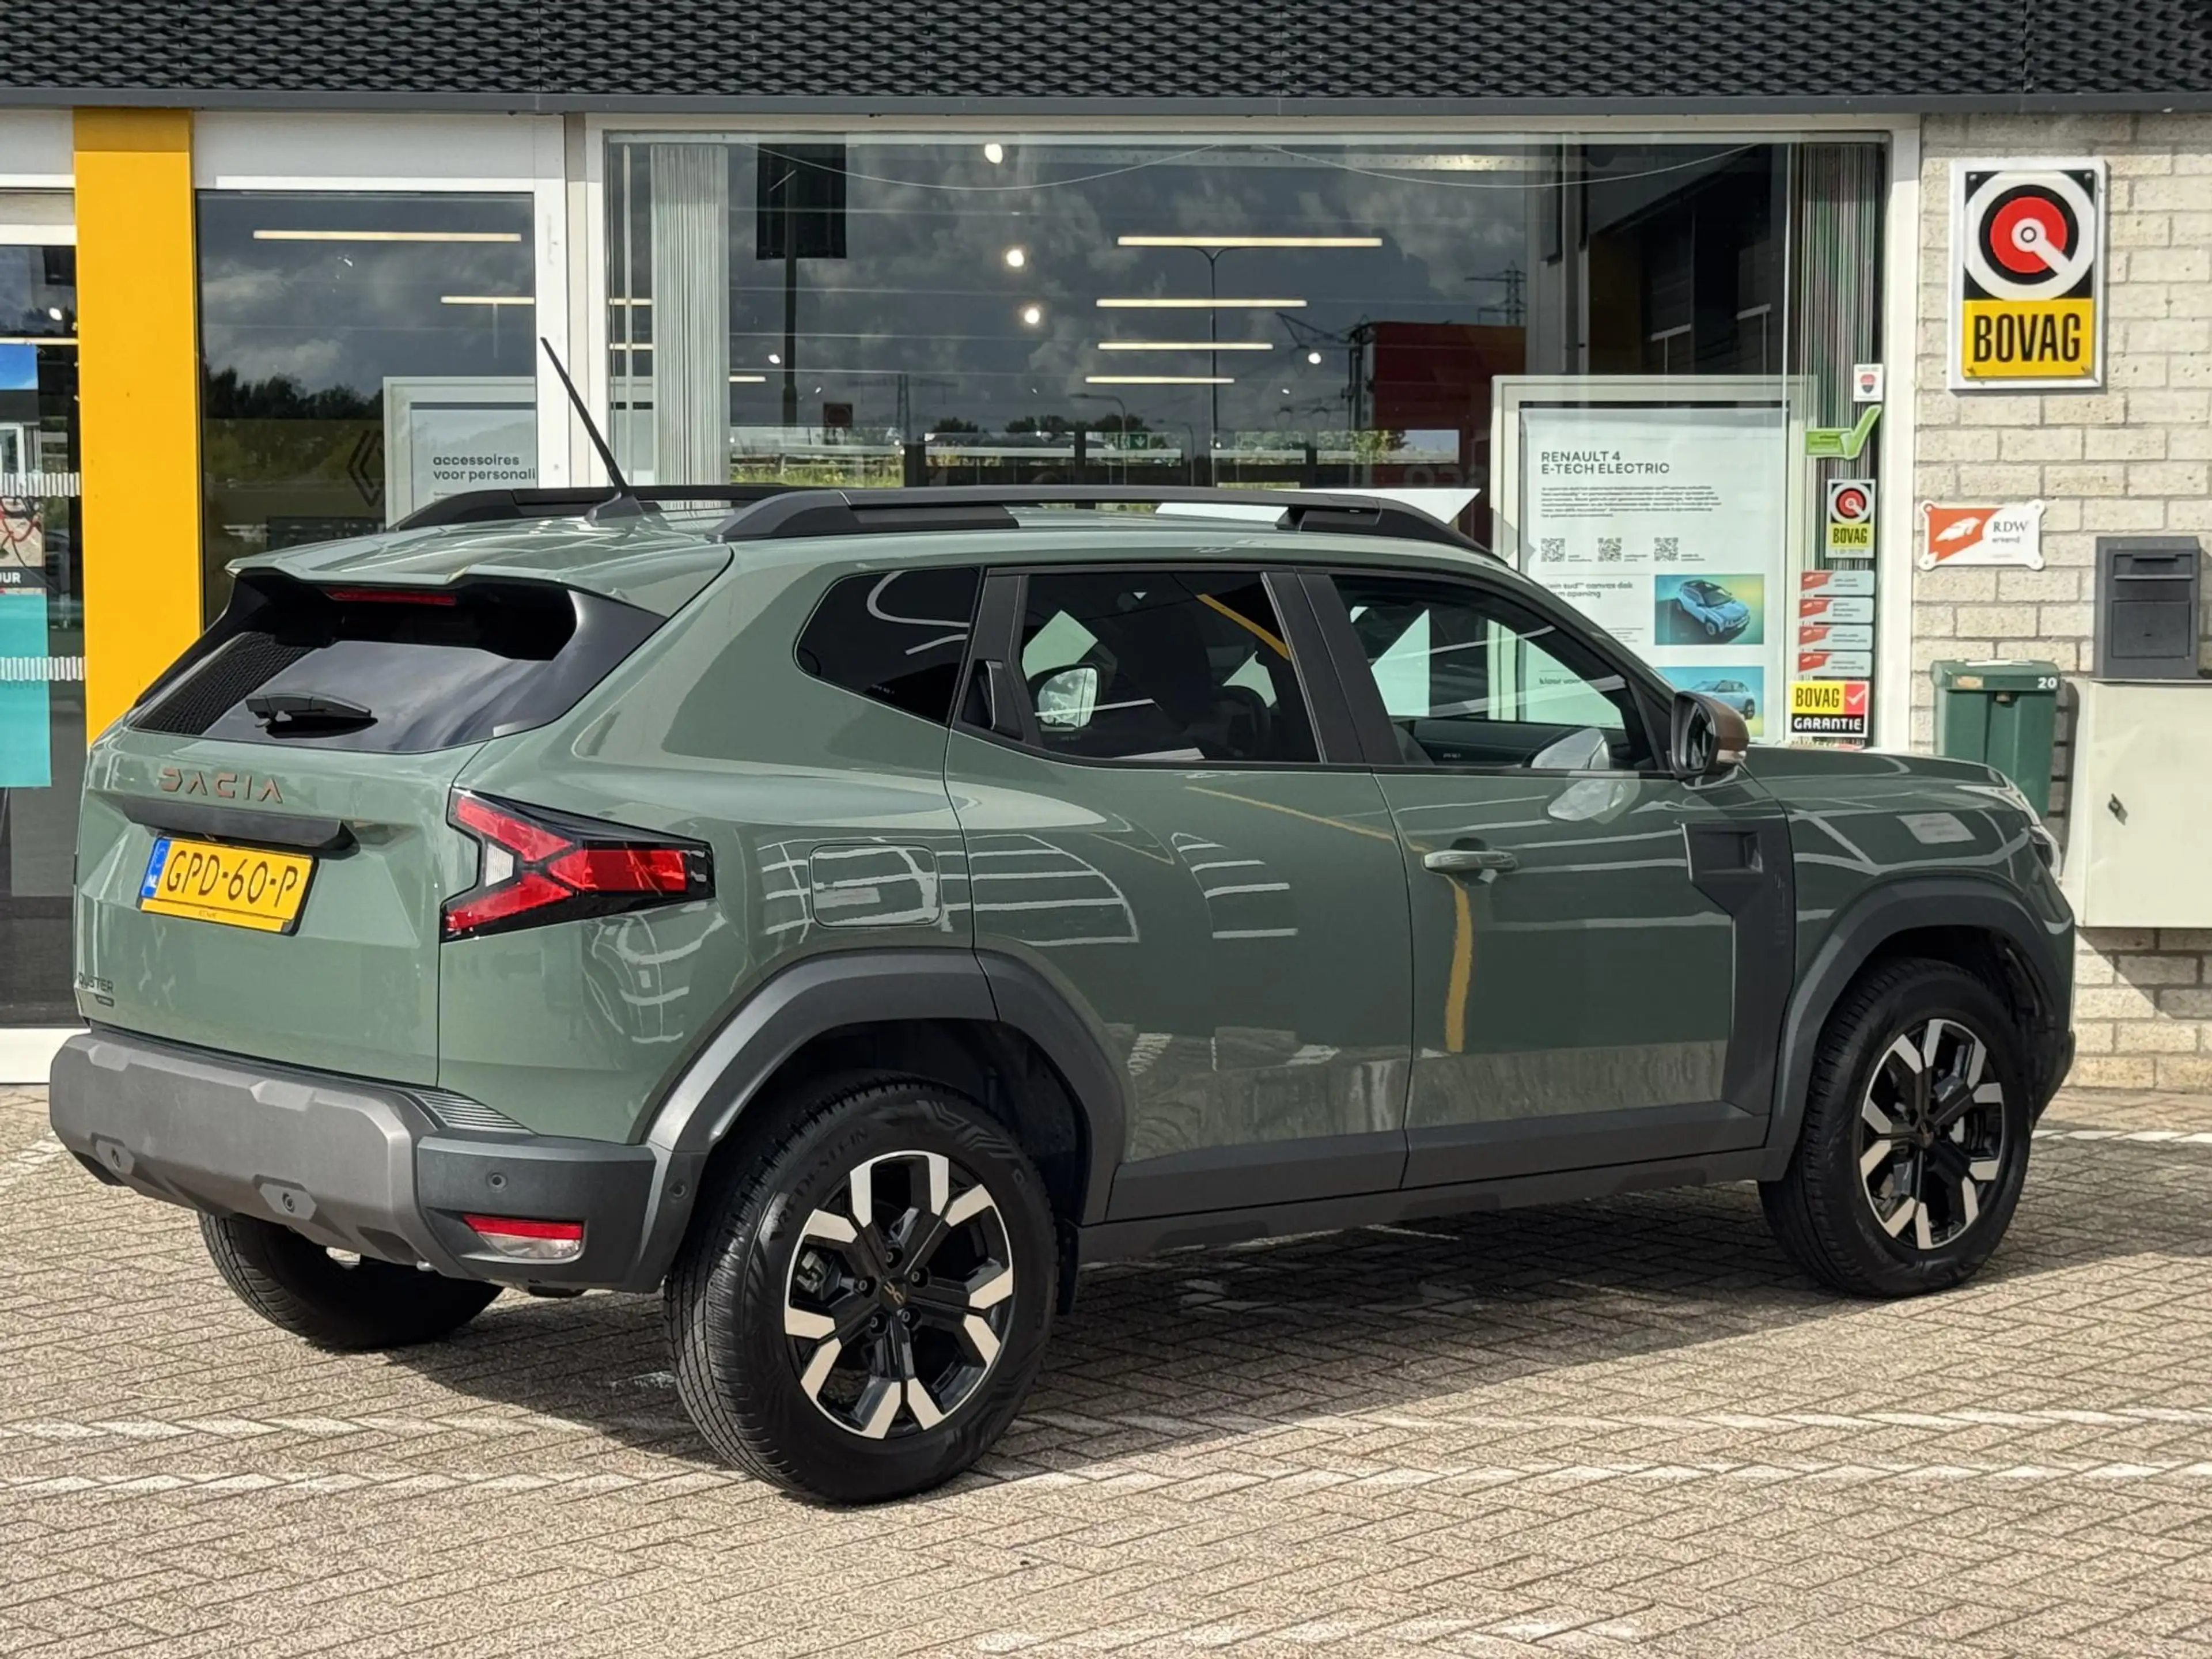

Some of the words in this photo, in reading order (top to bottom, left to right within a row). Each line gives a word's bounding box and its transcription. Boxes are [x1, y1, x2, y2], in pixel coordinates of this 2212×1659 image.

[1974, 313, 2080, 362] BOVAG
[433, 453, 519, 465] accessoires
[1541, 451, 1609, 462] RENAULT
[1612, 451, 1621, 461] 4
[433, 471, 466, 480] voor
[1541, 463, 1594, 475] E-TECH
[1598, 463, 1670, 474] ELECTRIC
[1993, 520, 2029, 533] RDW
[1833, 528, 1868, 544] BOVAG
[2037, 677, 2058, 689] 20
[1796, 687, 1840, 707] BOVAG
[1794, 717, 1862, 731] GARANTIE
[161, 768, 283, 804] DACIA
[166, 850, 298, 908] GPD-60-P
